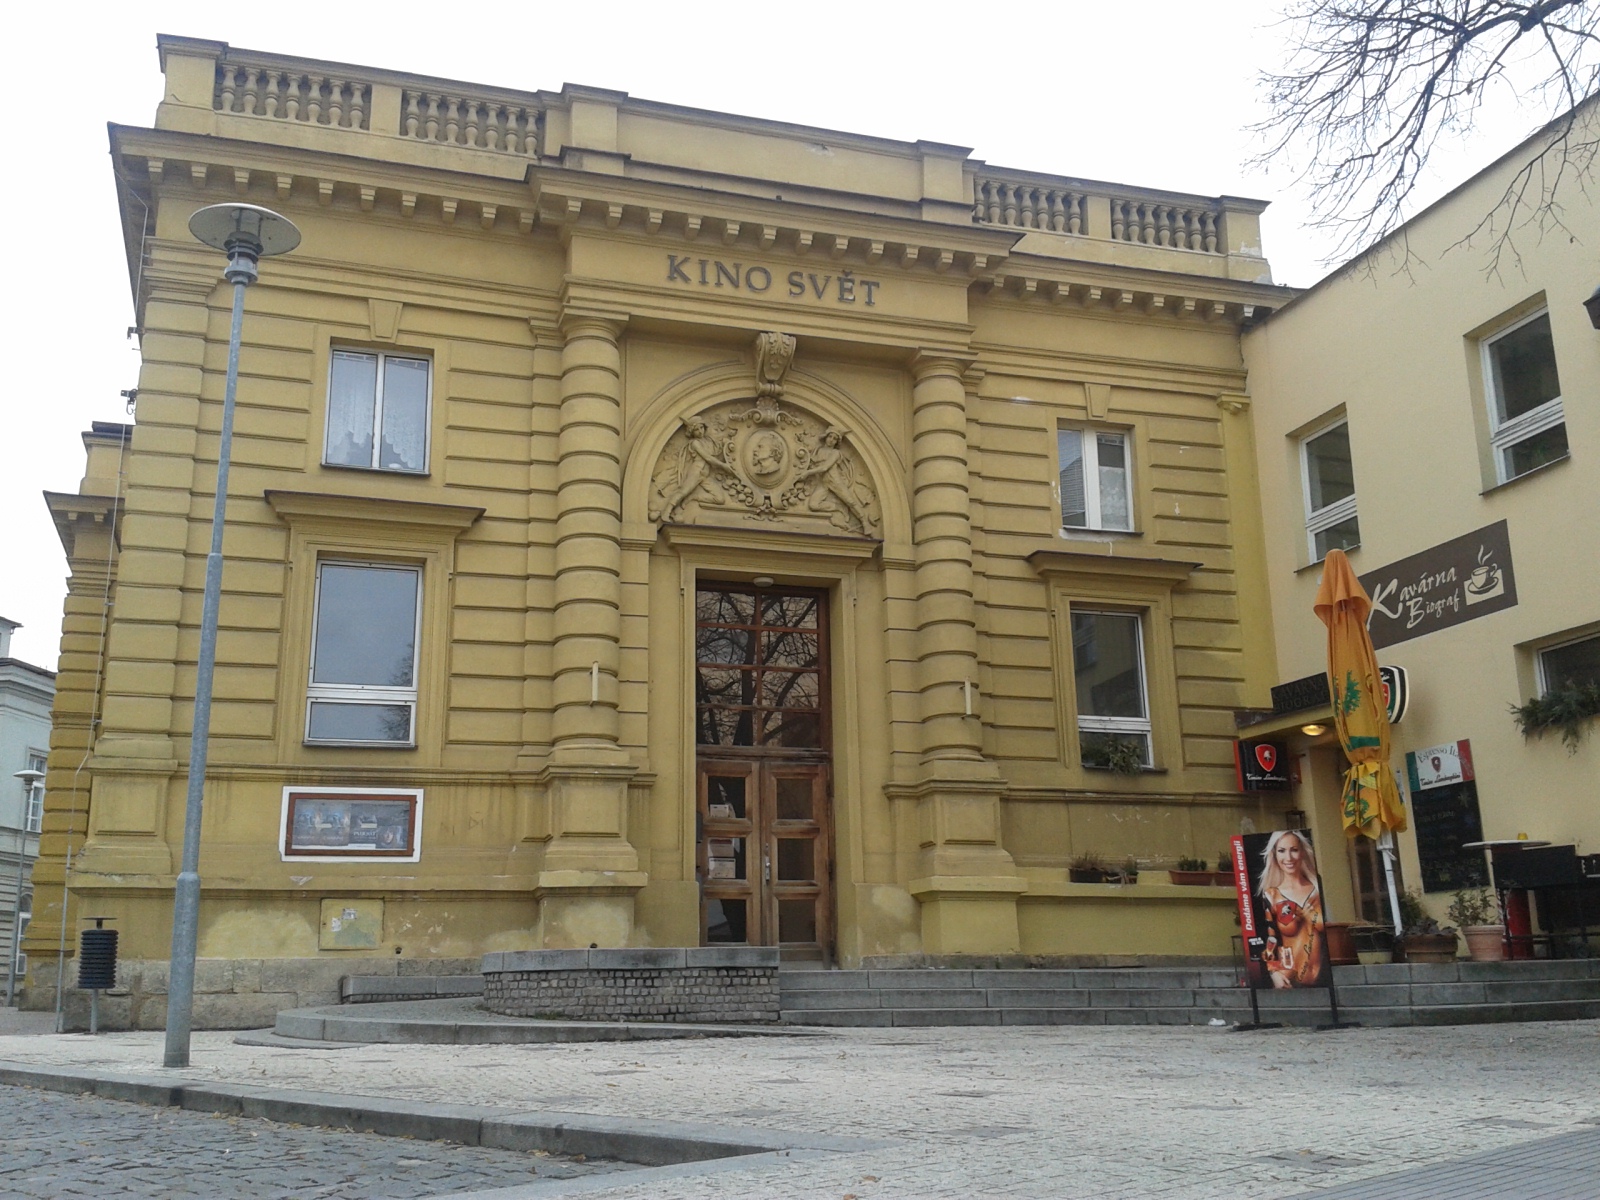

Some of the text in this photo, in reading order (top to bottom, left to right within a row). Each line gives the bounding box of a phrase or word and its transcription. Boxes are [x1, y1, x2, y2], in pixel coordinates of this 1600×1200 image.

[667, 254, 880, 306] KINO SVĚT
[1366, 567, 1457, 631] Kavárna
[1406, 588, 1460, 629] Biograf
[1233, 840, 1253, 931] Dodáme vám energii
